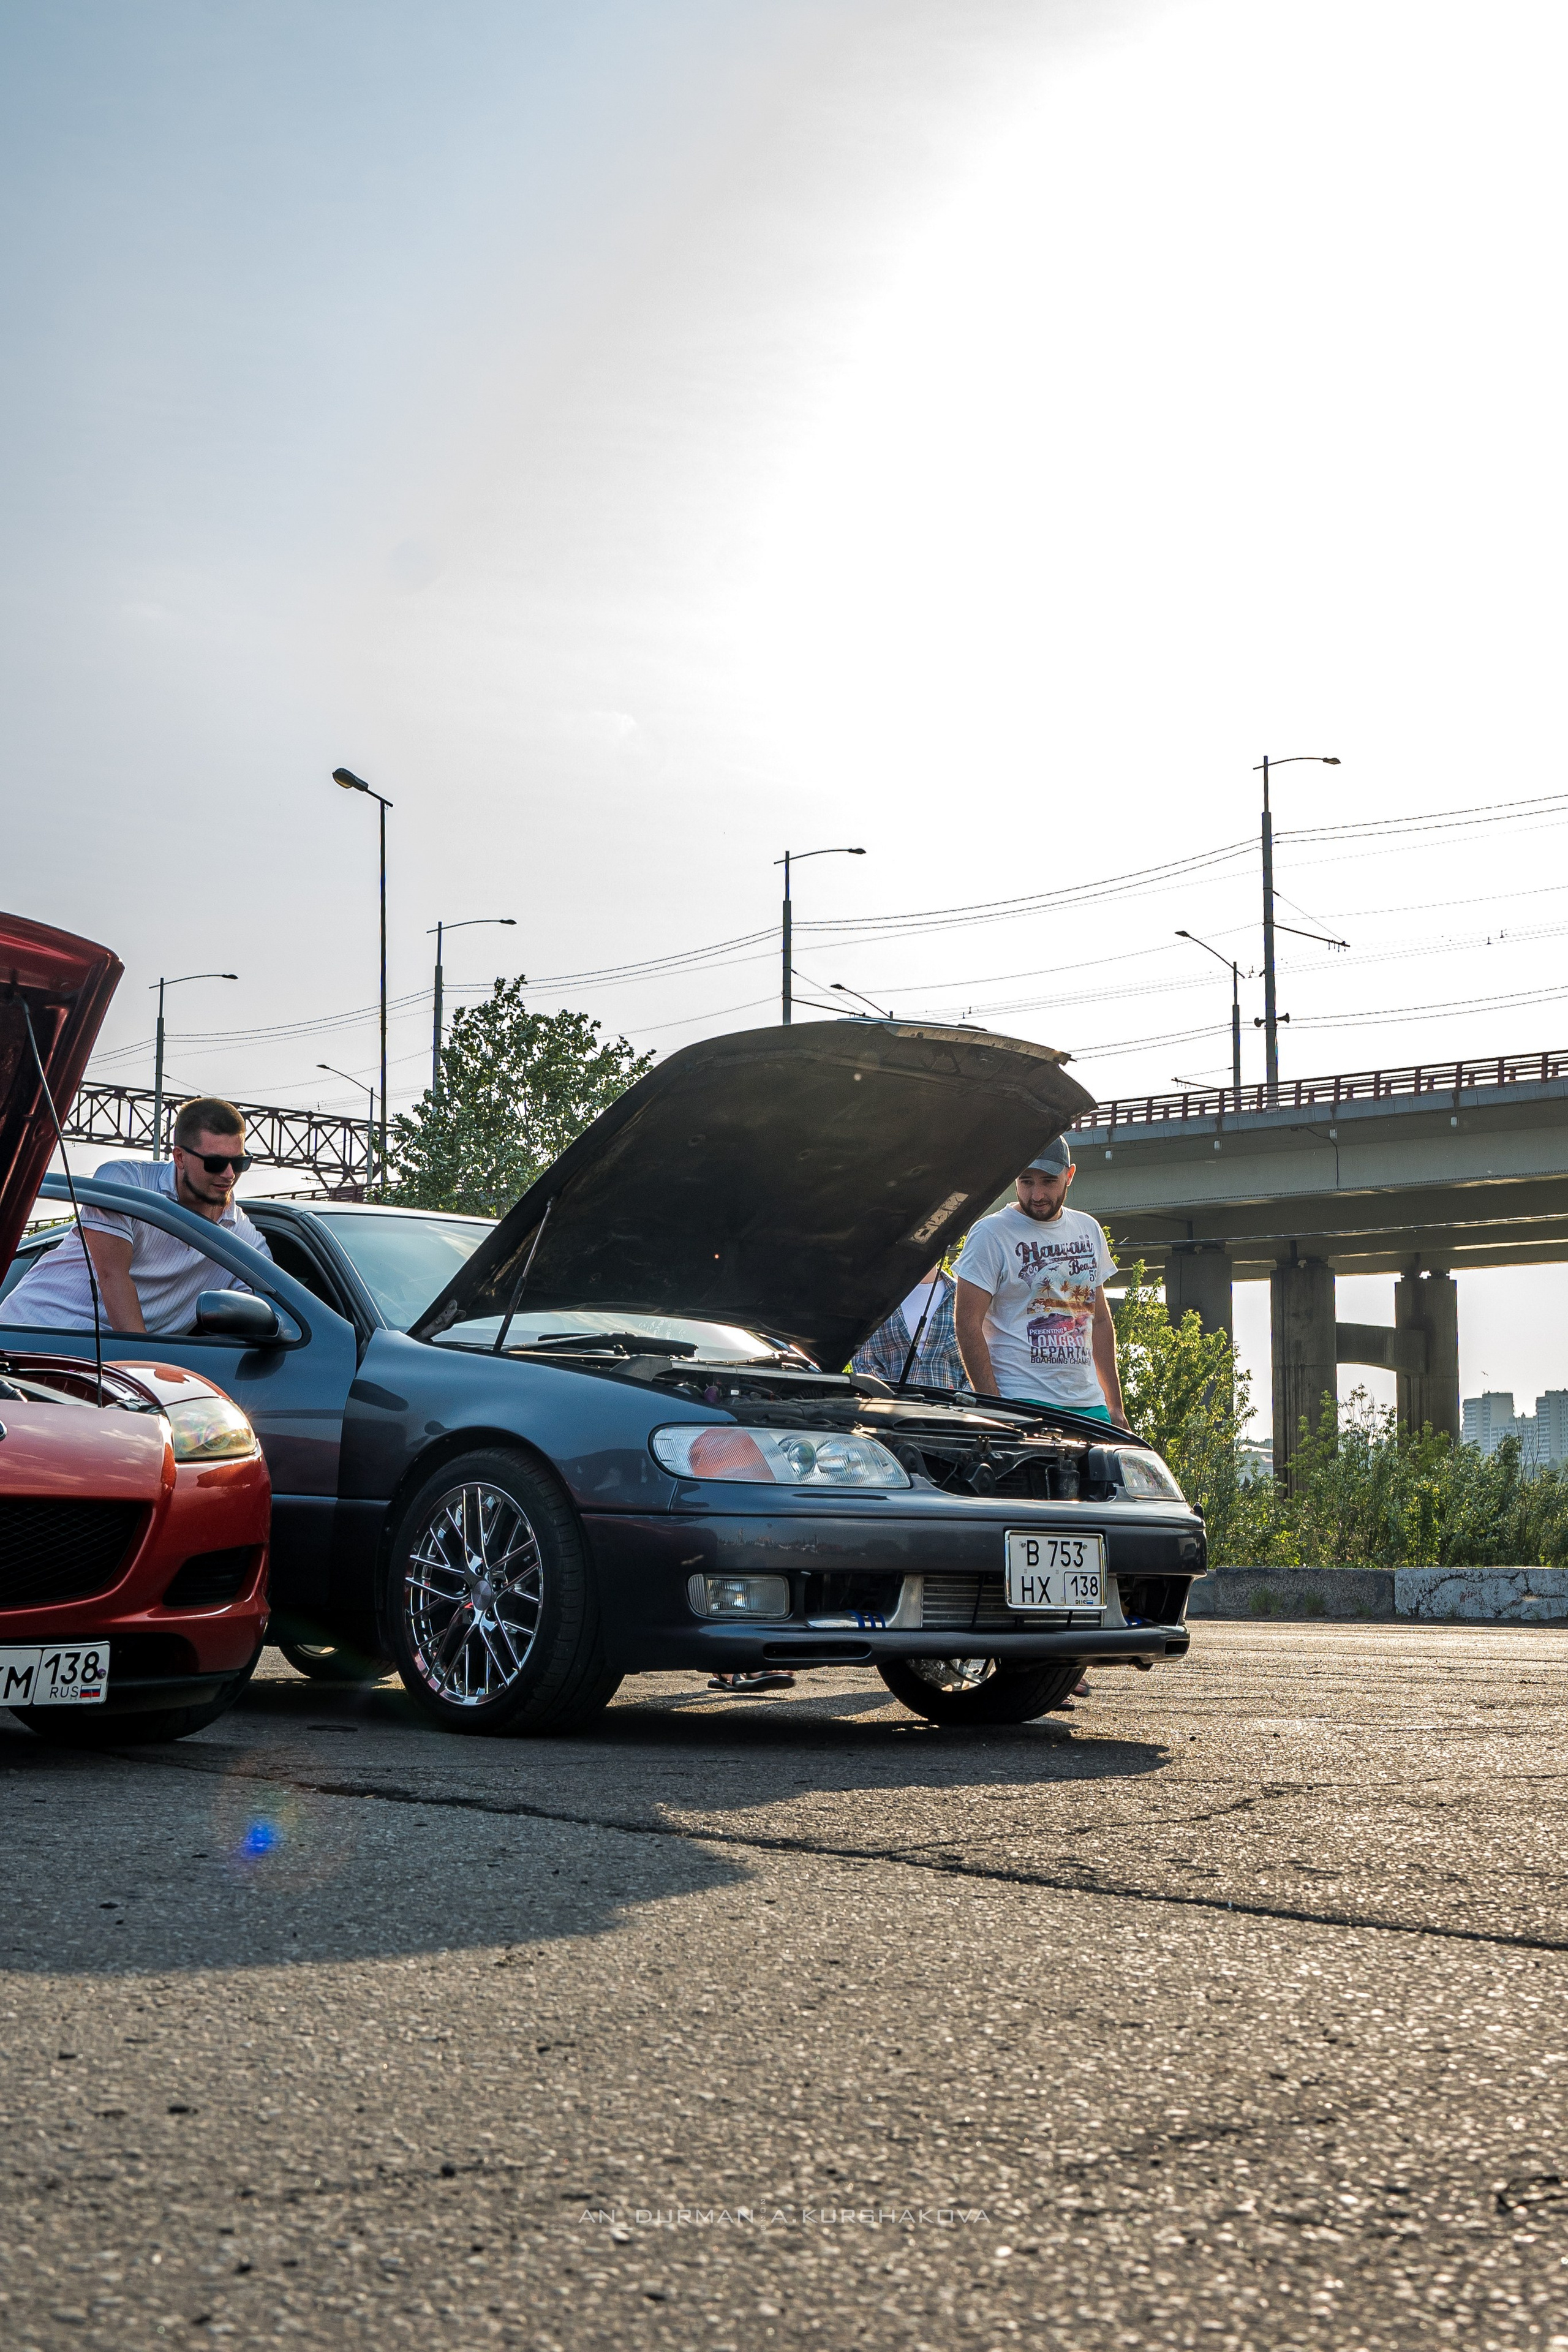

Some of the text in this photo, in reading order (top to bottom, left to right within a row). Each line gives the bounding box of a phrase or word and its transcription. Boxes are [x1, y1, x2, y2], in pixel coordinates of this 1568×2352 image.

[1015, 1234, 1094, 1265] Hawaii
[1027, 1539, 1084, 1567] B 753
[1021, 1575, 1099, 1604] HX 138
[0, 1651, 100, 1699] M 138
[50, 1686, 79, 1698] RUS
